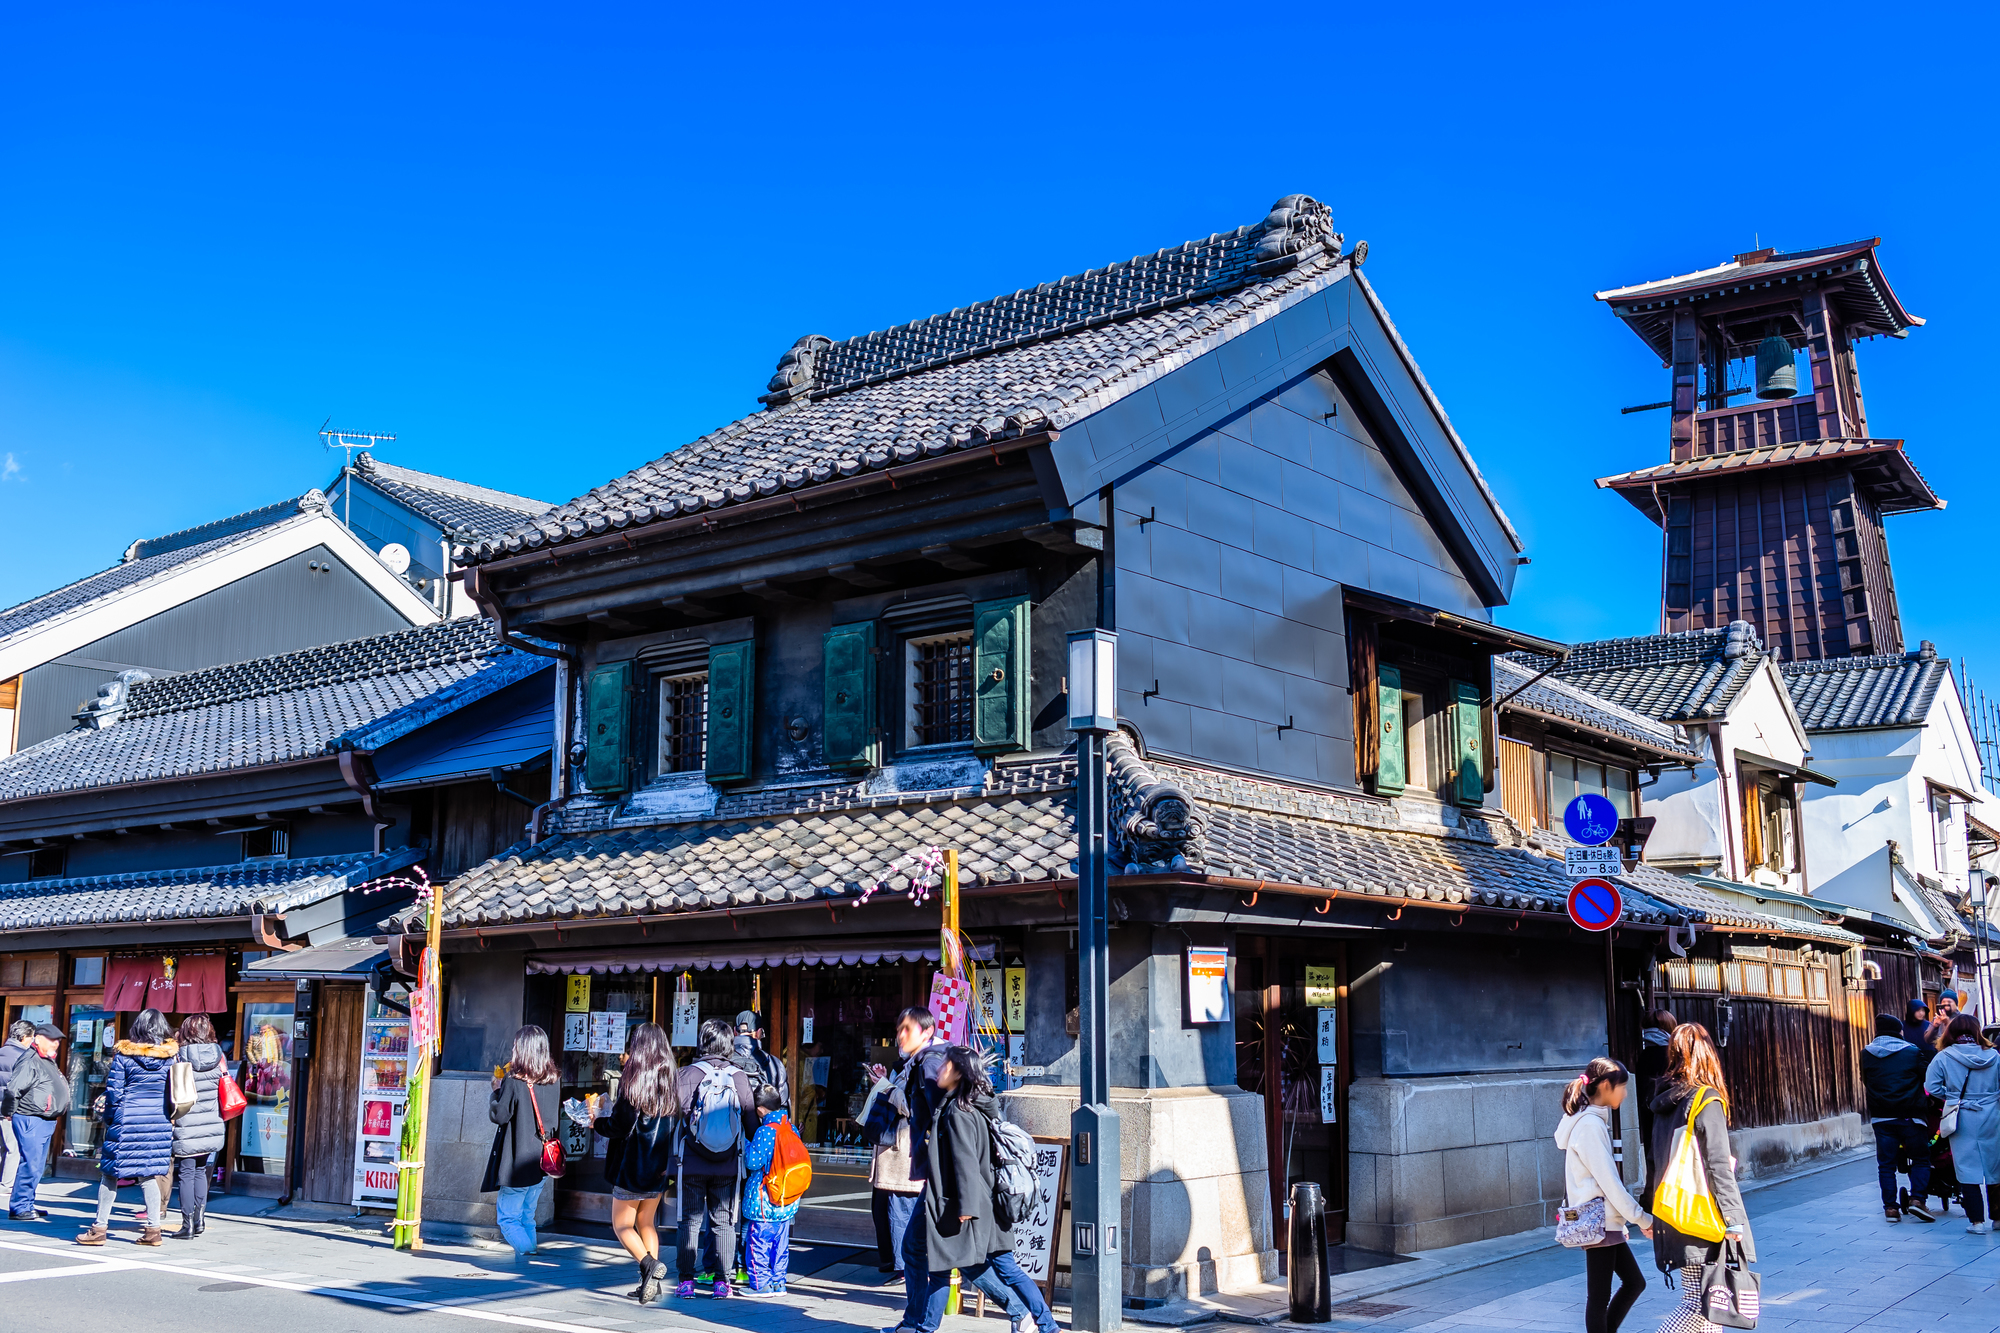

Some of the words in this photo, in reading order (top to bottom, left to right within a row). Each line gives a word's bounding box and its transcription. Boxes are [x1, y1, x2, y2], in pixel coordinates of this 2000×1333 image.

[982, 976, 994, 1019] 新酒粕
[368, 1119, 390, 1129] 午後の紅茶
[568, 1122, 586, 1153] 鏡山
